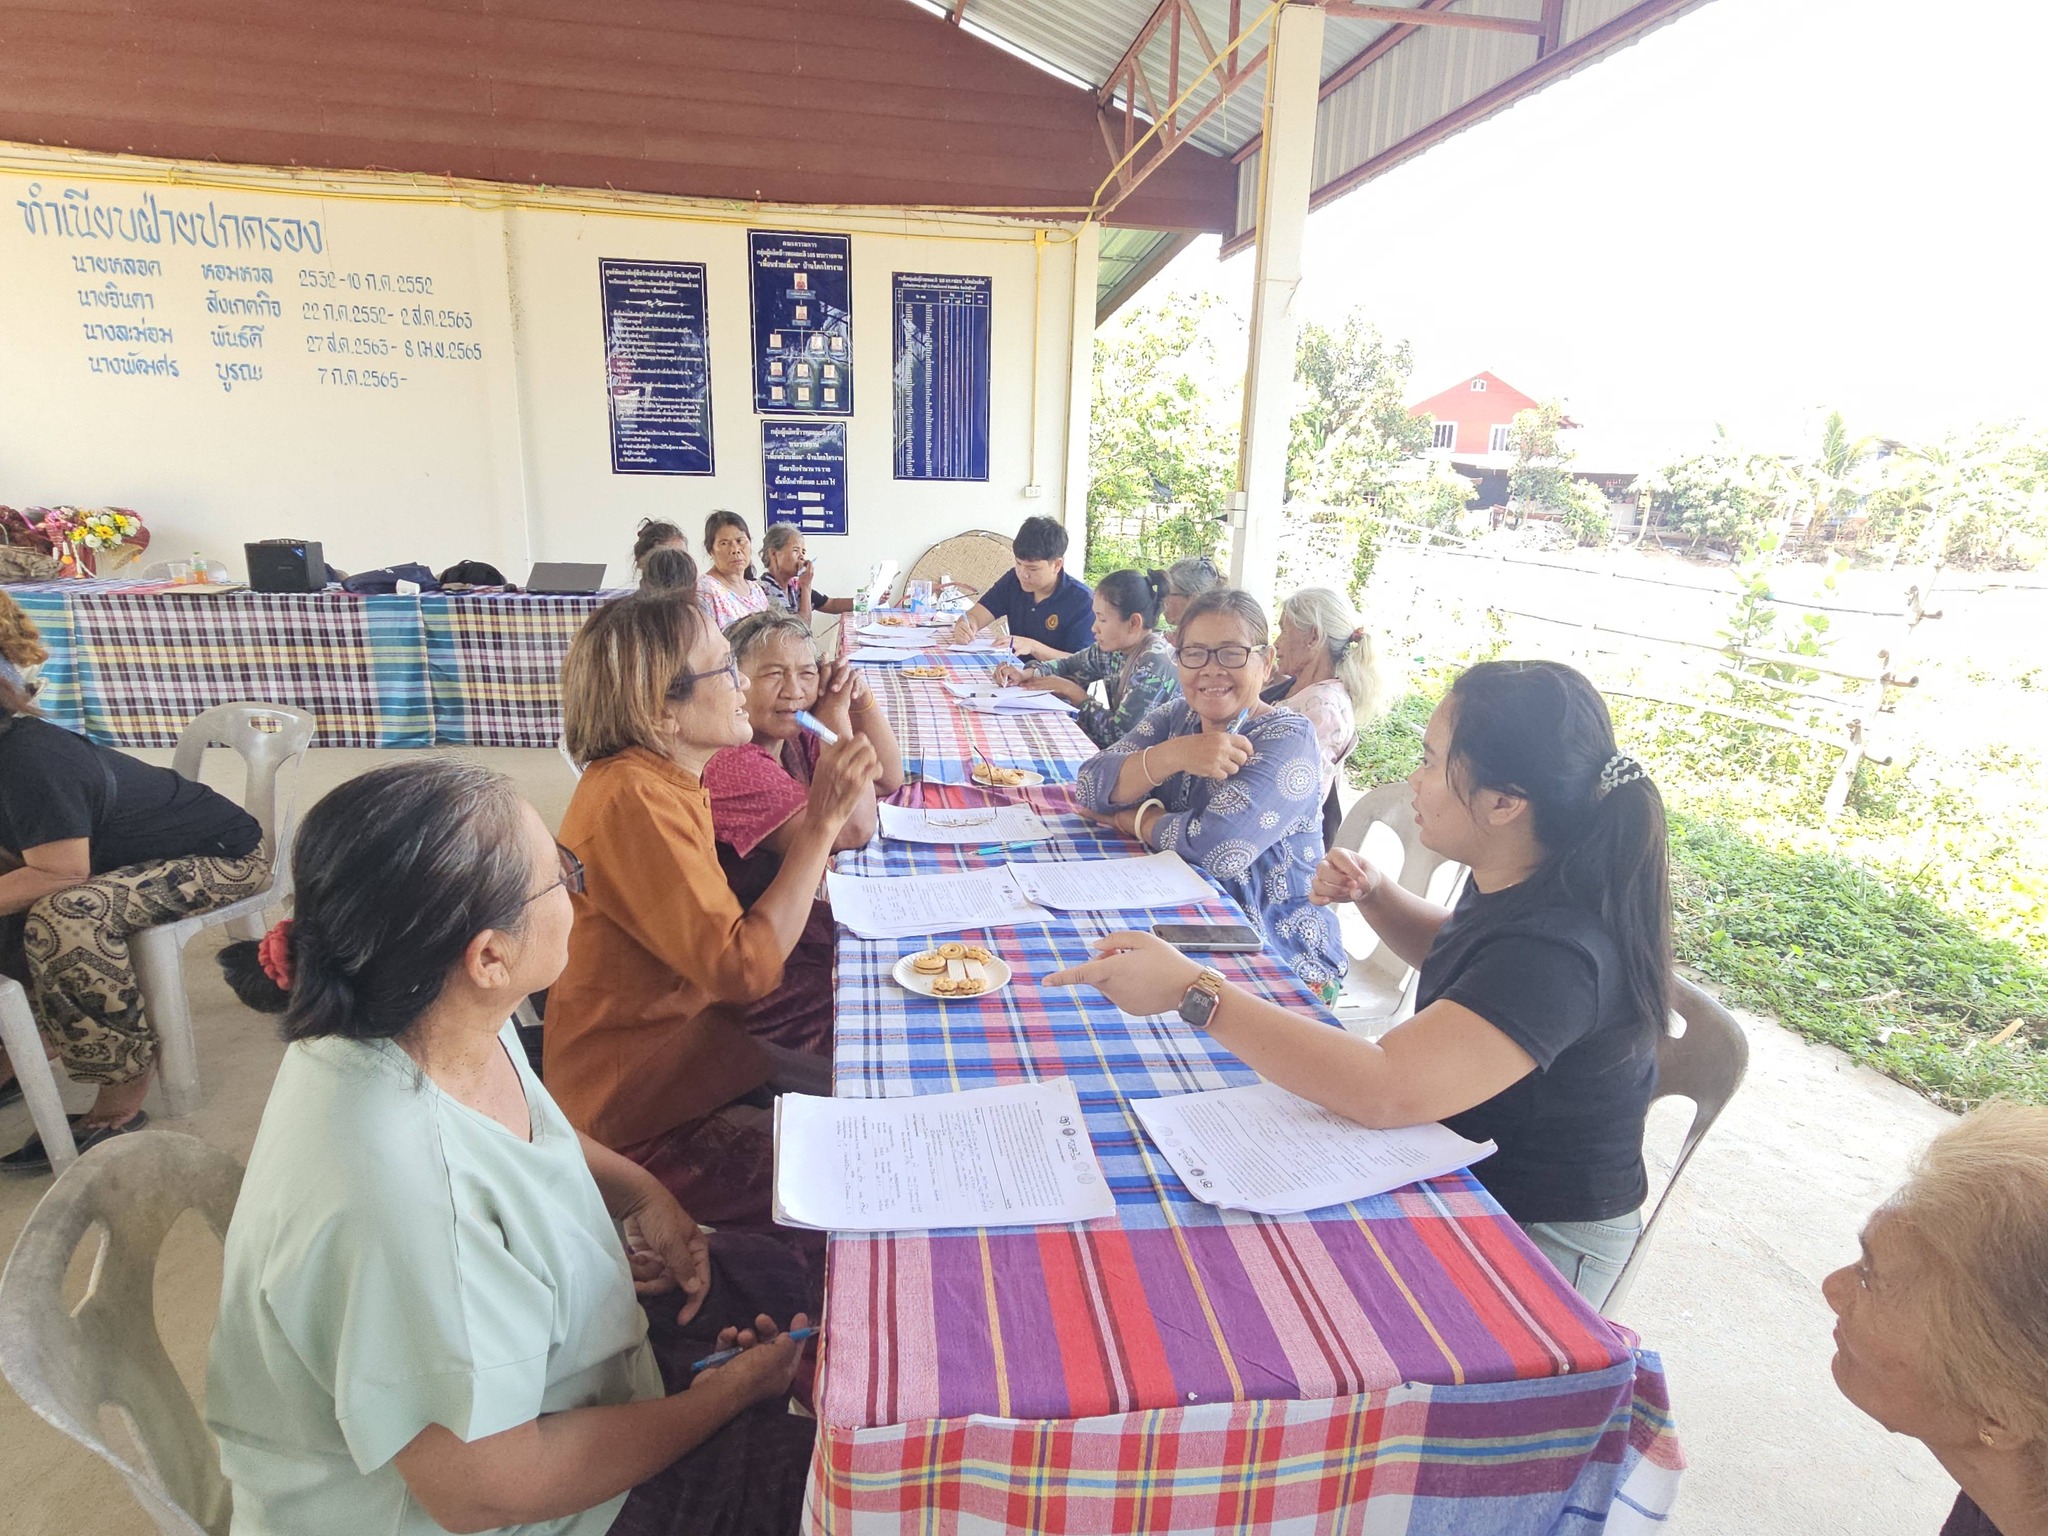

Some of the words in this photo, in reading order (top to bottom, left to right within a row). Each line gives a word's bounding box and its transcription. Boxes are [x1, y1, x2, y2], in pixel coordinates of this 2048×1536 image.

[16, 182, 323, 255] ทำเนียบฝ่ายปกครอง
[201, 263, 274, 284] หอมหวล
[302, 302, 320, 321] 22
[400, 308, 411, 326] 2
[83, 317, 174, 344] นางละม่อม
[306, 335, 323, 353] 27
[404, 339, 414, 358] 8
[215, 362, 263, 392] บูรณะ
[317, 367, 328, 385] 7
